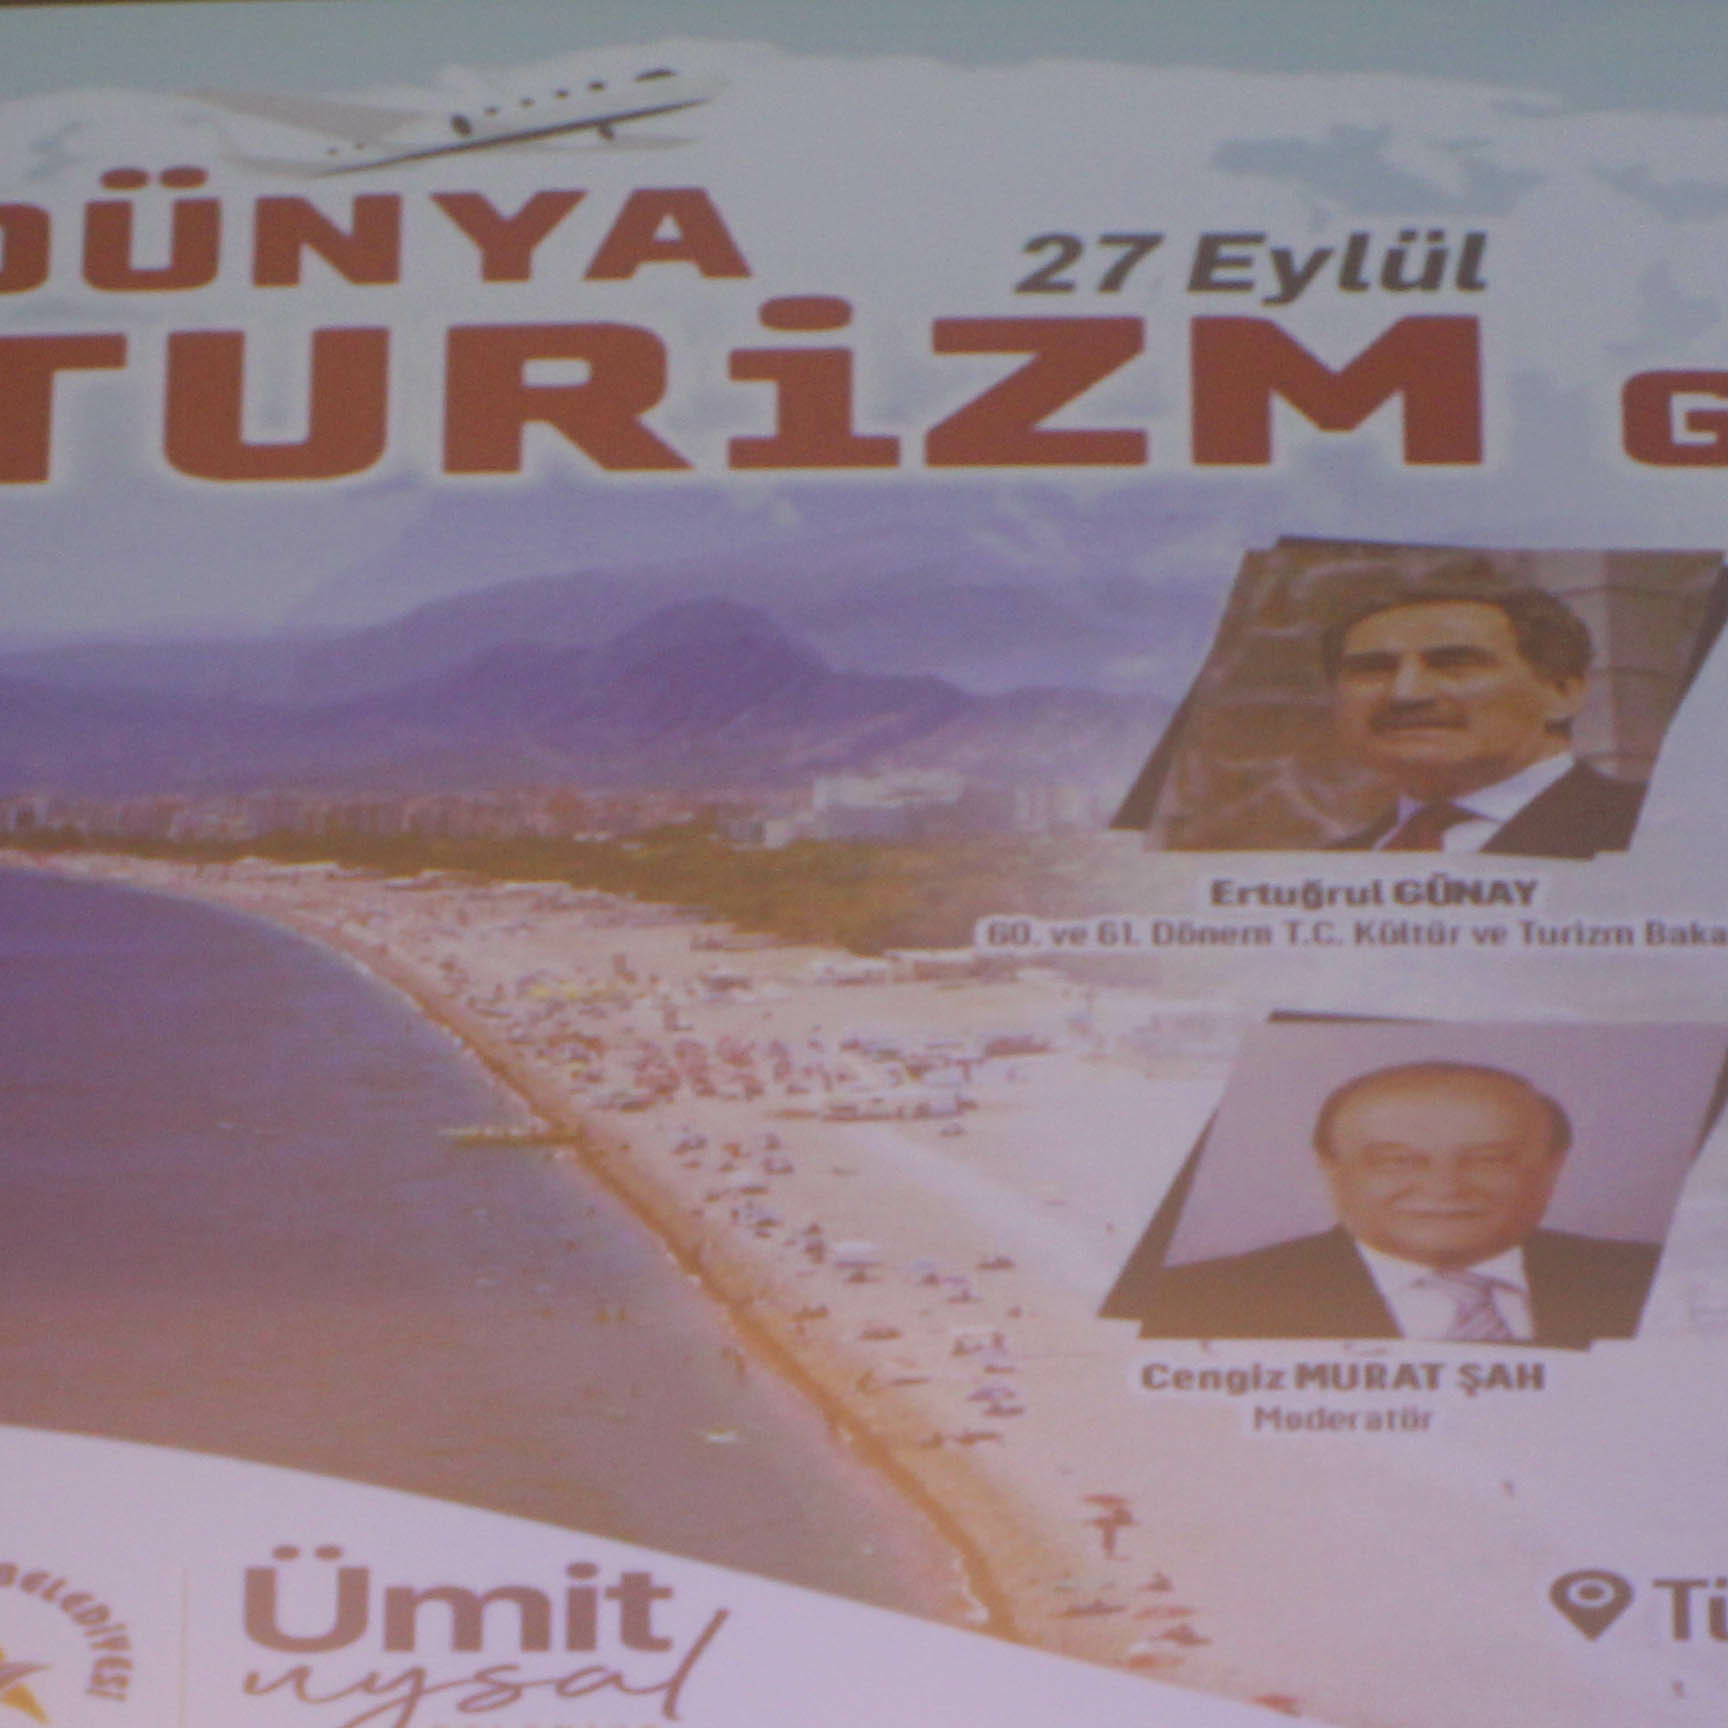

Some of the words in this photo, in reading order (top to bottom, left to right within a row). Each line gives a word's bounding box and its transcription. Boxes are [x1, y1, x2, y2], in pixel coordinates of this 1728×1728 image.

[1014, 232, 1153, 295] 27
[1186, 230, 1490, 306] Eylül
[1211, 877, 1385, 911] Ertuğrul
[1393, 872, 1539, 908] GÜNAY
[1051, 925, 1088, 947] ve
[1153, 917, 1271, 948] Dönem
[1284, 918, 1343, 947] T.C.
[1354, 916, 1460, 947] Kültür
[1472, 926, 1506, 948] ve
[1520, 920, 1634, 948] Turizm
[1140, 1362, 1286, 1395] Cengiz
[1294, 1362, 1446, 1391] MURAT
[1458, 1362, 1547, 1397] ŞAH
[1253, 1405, 1435, 1433] Moderatör
[243, 1544, 678, 1655] Ümit
